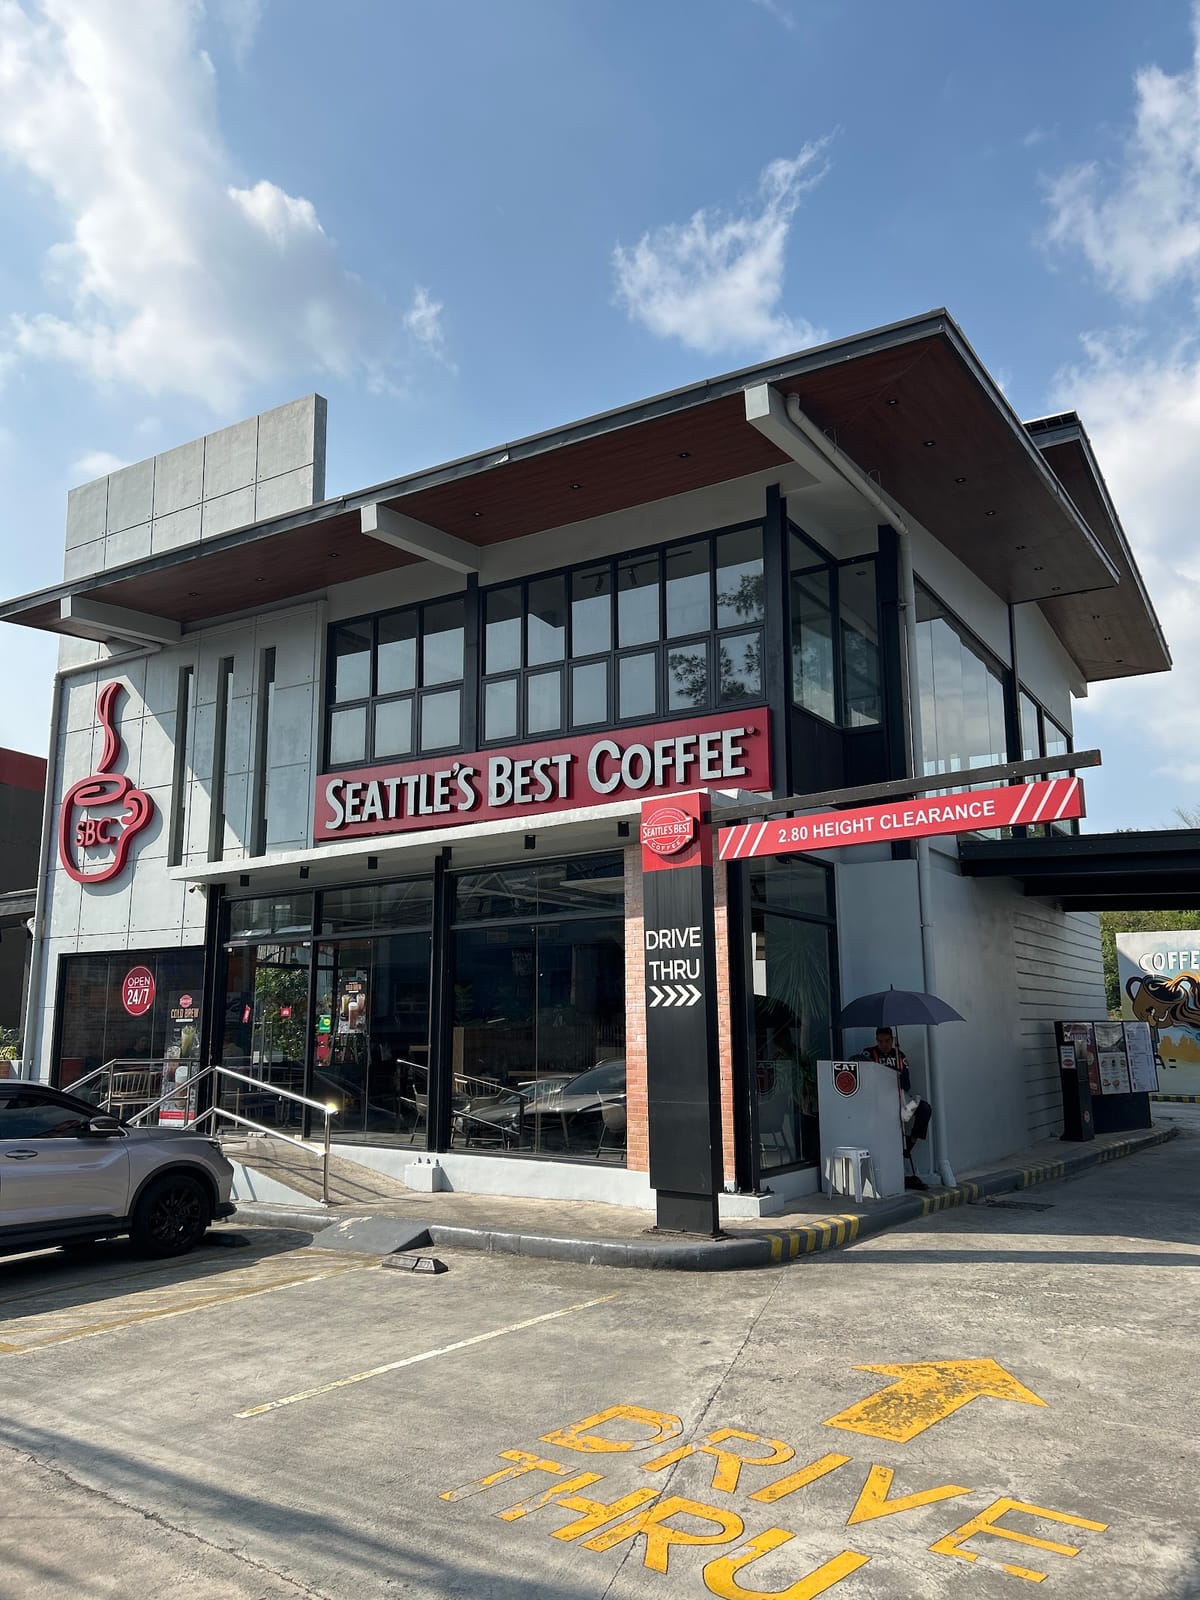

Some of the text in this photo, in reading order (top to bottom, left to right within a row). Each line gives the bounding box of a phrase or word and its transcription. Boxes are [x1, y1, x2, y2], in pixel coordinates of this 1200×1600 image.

[325, 727, 746, 830] SEATTLE'S BEST COFFEE
[75, 817, 112, 847] SBC
[642, 822, 691, 838] SEATTLE'S BEST
[778, 800, 995, 844] 2.80 HEIGHT CLEARANCE
[651, 840, 681, 851] COFFEE
[645, 926, 702, 950] DRIVE
[648, 958, 700, 981] THRU
[127, 976, 151, 987] OPEN
[127, 988, 149, 1006] 24/7
[834, 1063, 856, 1071] CAT
[538, 1403, 1109, 1584] DRIVE
[438, 1448, 872, 1600] THRU
